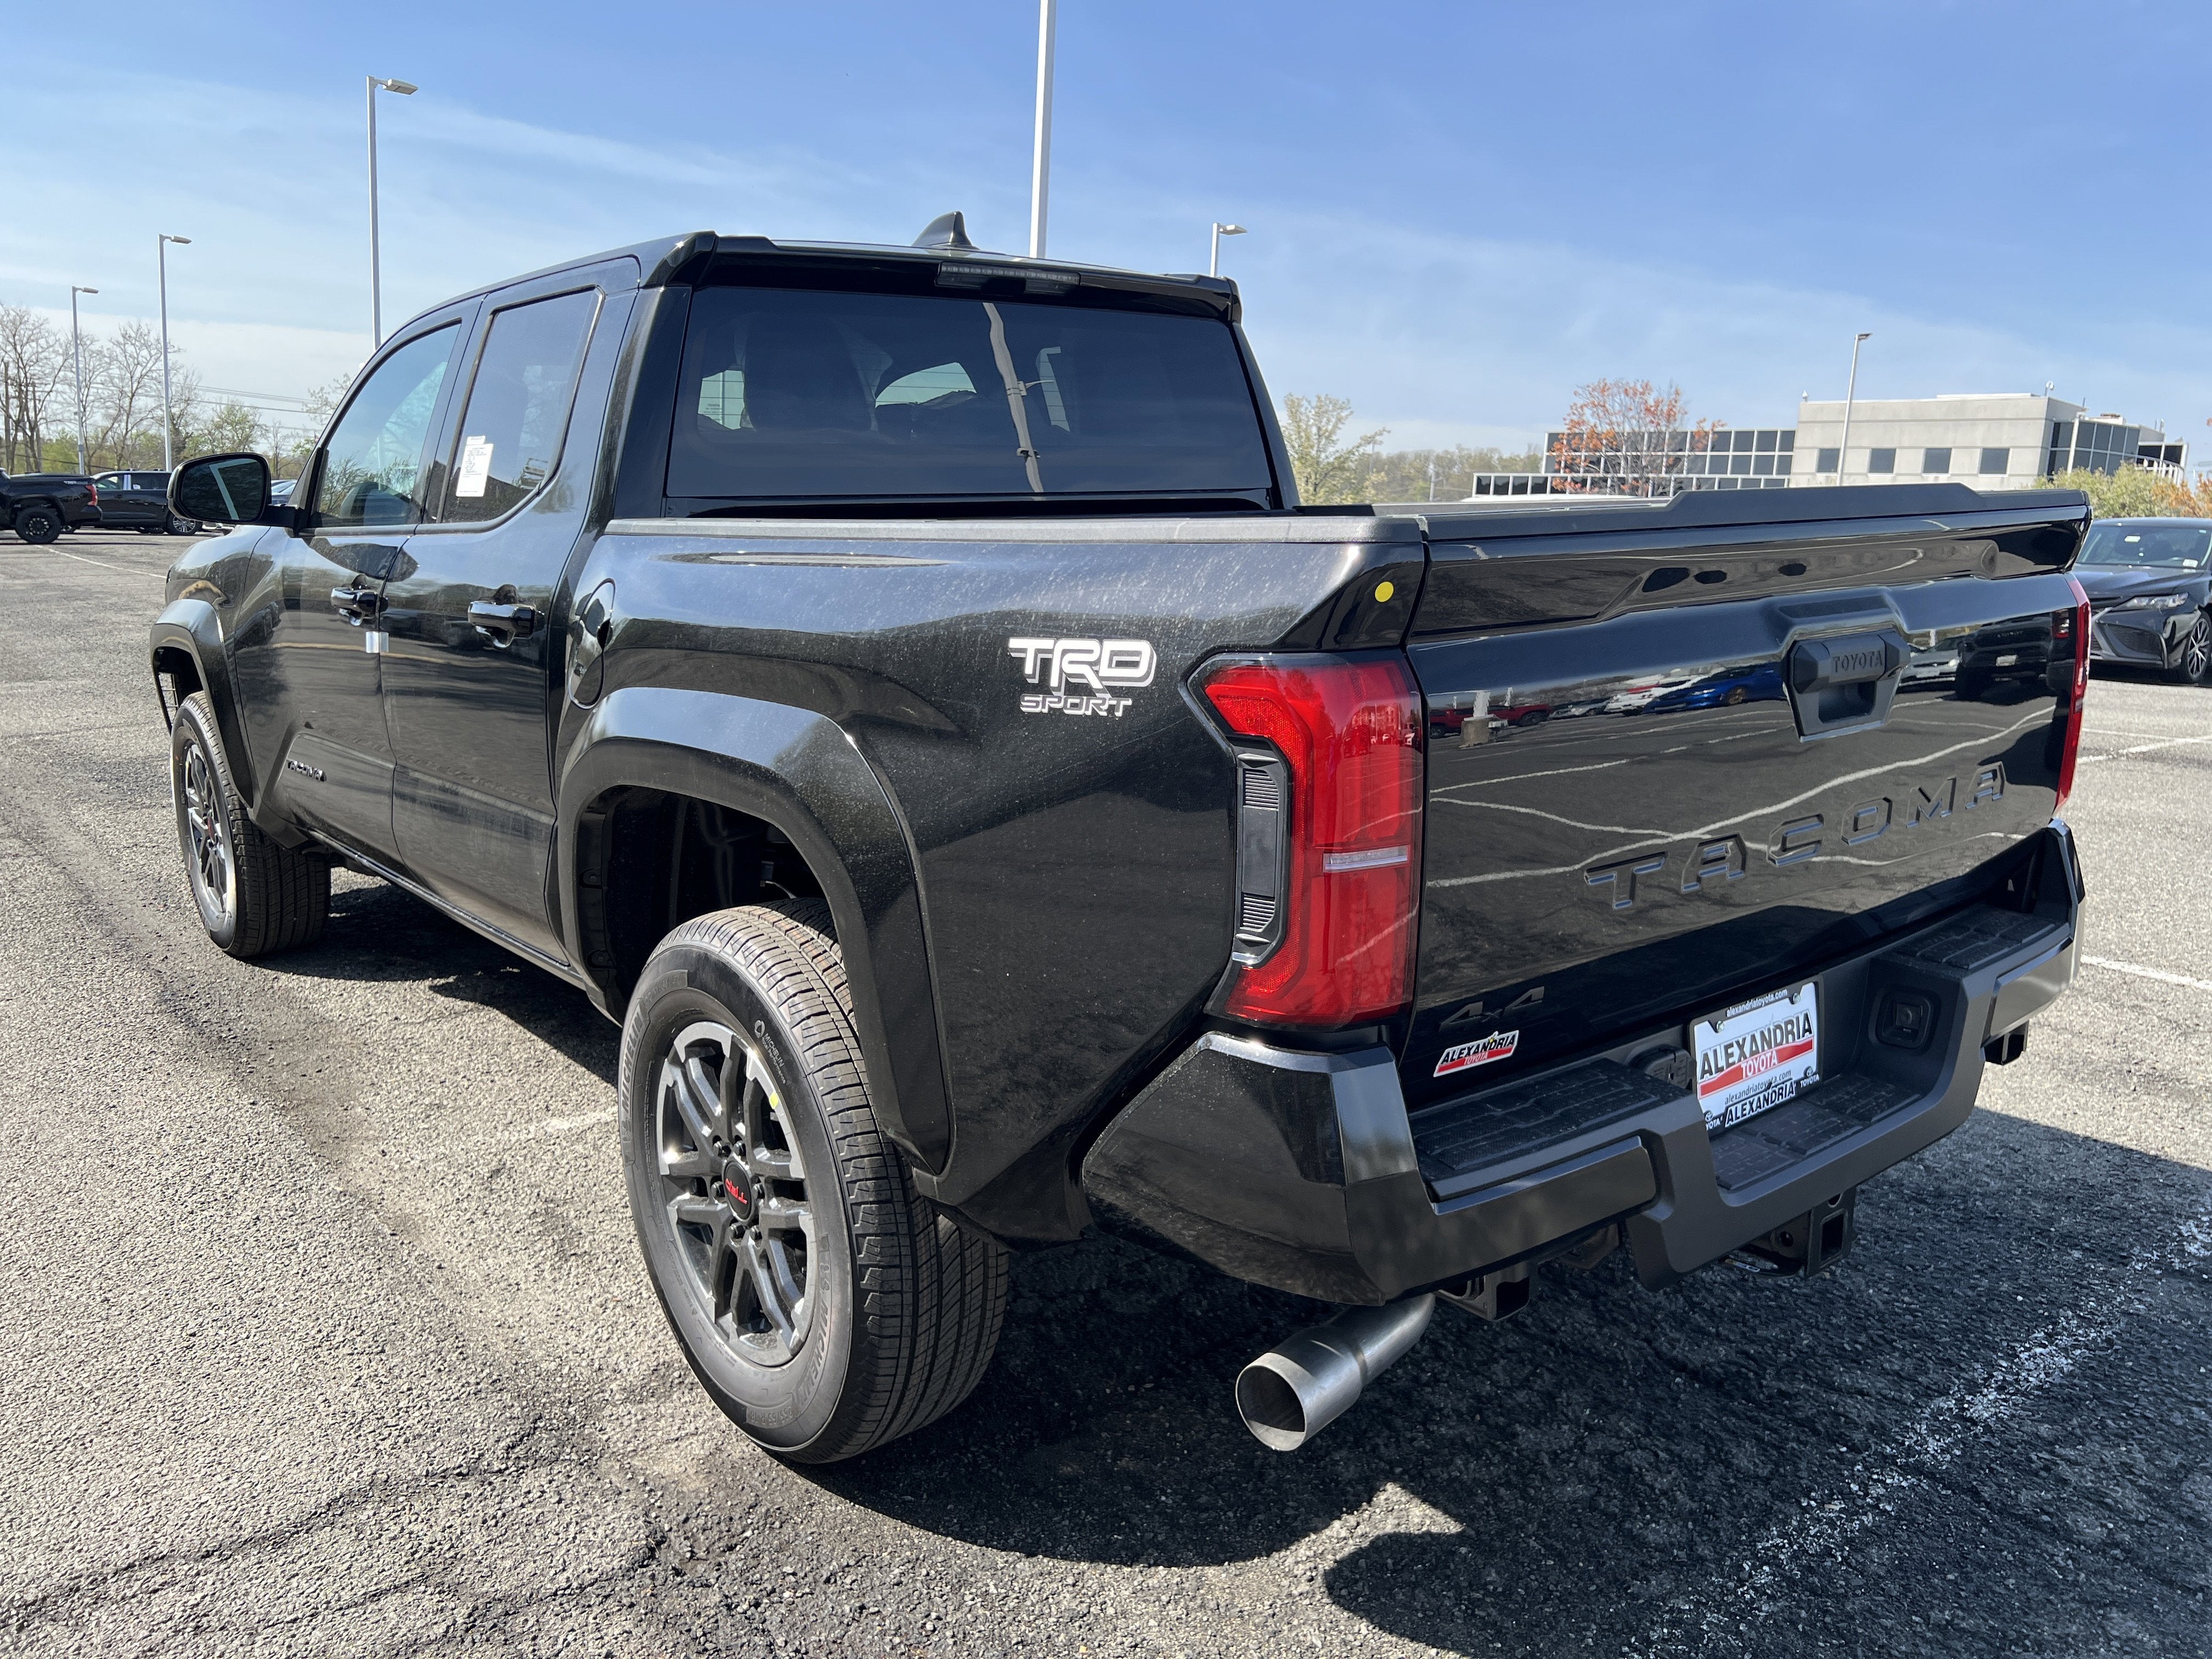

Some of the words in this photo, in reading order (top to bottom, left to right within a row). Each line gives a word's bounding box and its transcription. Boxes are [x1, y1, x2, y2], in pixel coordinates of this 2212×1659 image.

[1008, 637, 1157, 698] TRD
[1833, 650, 1883, 673] TOYOTA
[1020, 693, 1132, 717] SPORT
[1584, 760, 2007, 910] TACOMA
[1726, 989, 1788, 1017] alexandriatoyota.com
[764, 1033, 785, 1067] MICHELIN
[1440, 1034, 1516, 1065] ALEXANDRIA
[1464, 1052, 1488, 1065] TOYOTA
[1700, 1012, 1813, 1080] ALEXANDRIA
[1741, 1050, 1778, 1079] TOYOTA
[1800, 1074, 1820, 1088] TOYOTA
[1725, 1085, 1795, 1125] ALEXANDRIA
[1706, 1118, 1720, 1131] YOTA
